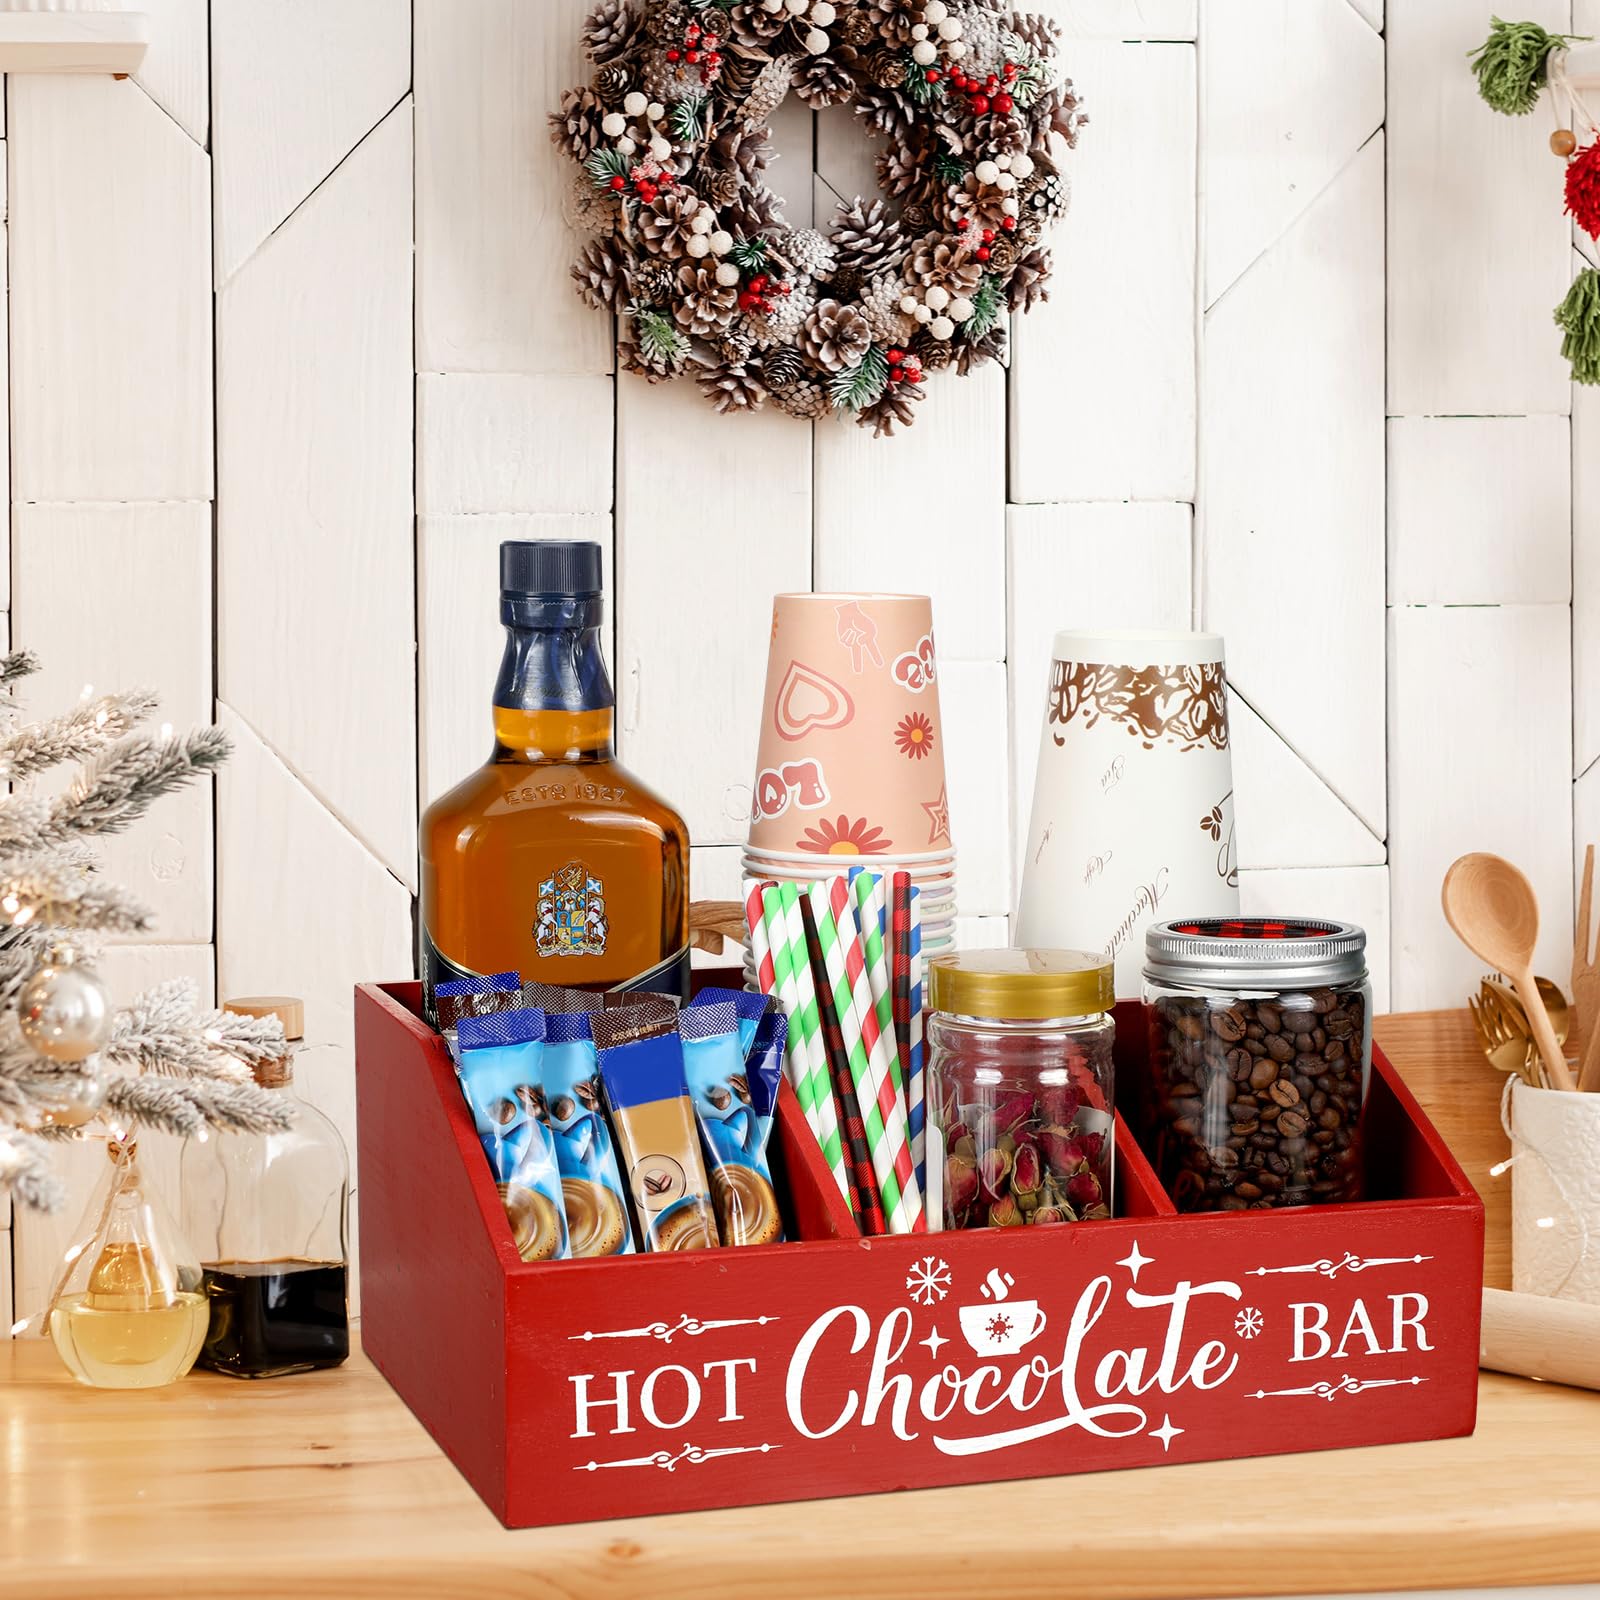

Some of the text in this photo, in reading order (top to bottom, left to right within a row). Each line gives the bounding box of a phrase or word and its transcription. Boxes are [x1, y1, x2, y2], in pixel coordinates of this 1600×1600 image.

[568, 1276, 1434, 1456] HOT Chocolate BAR
